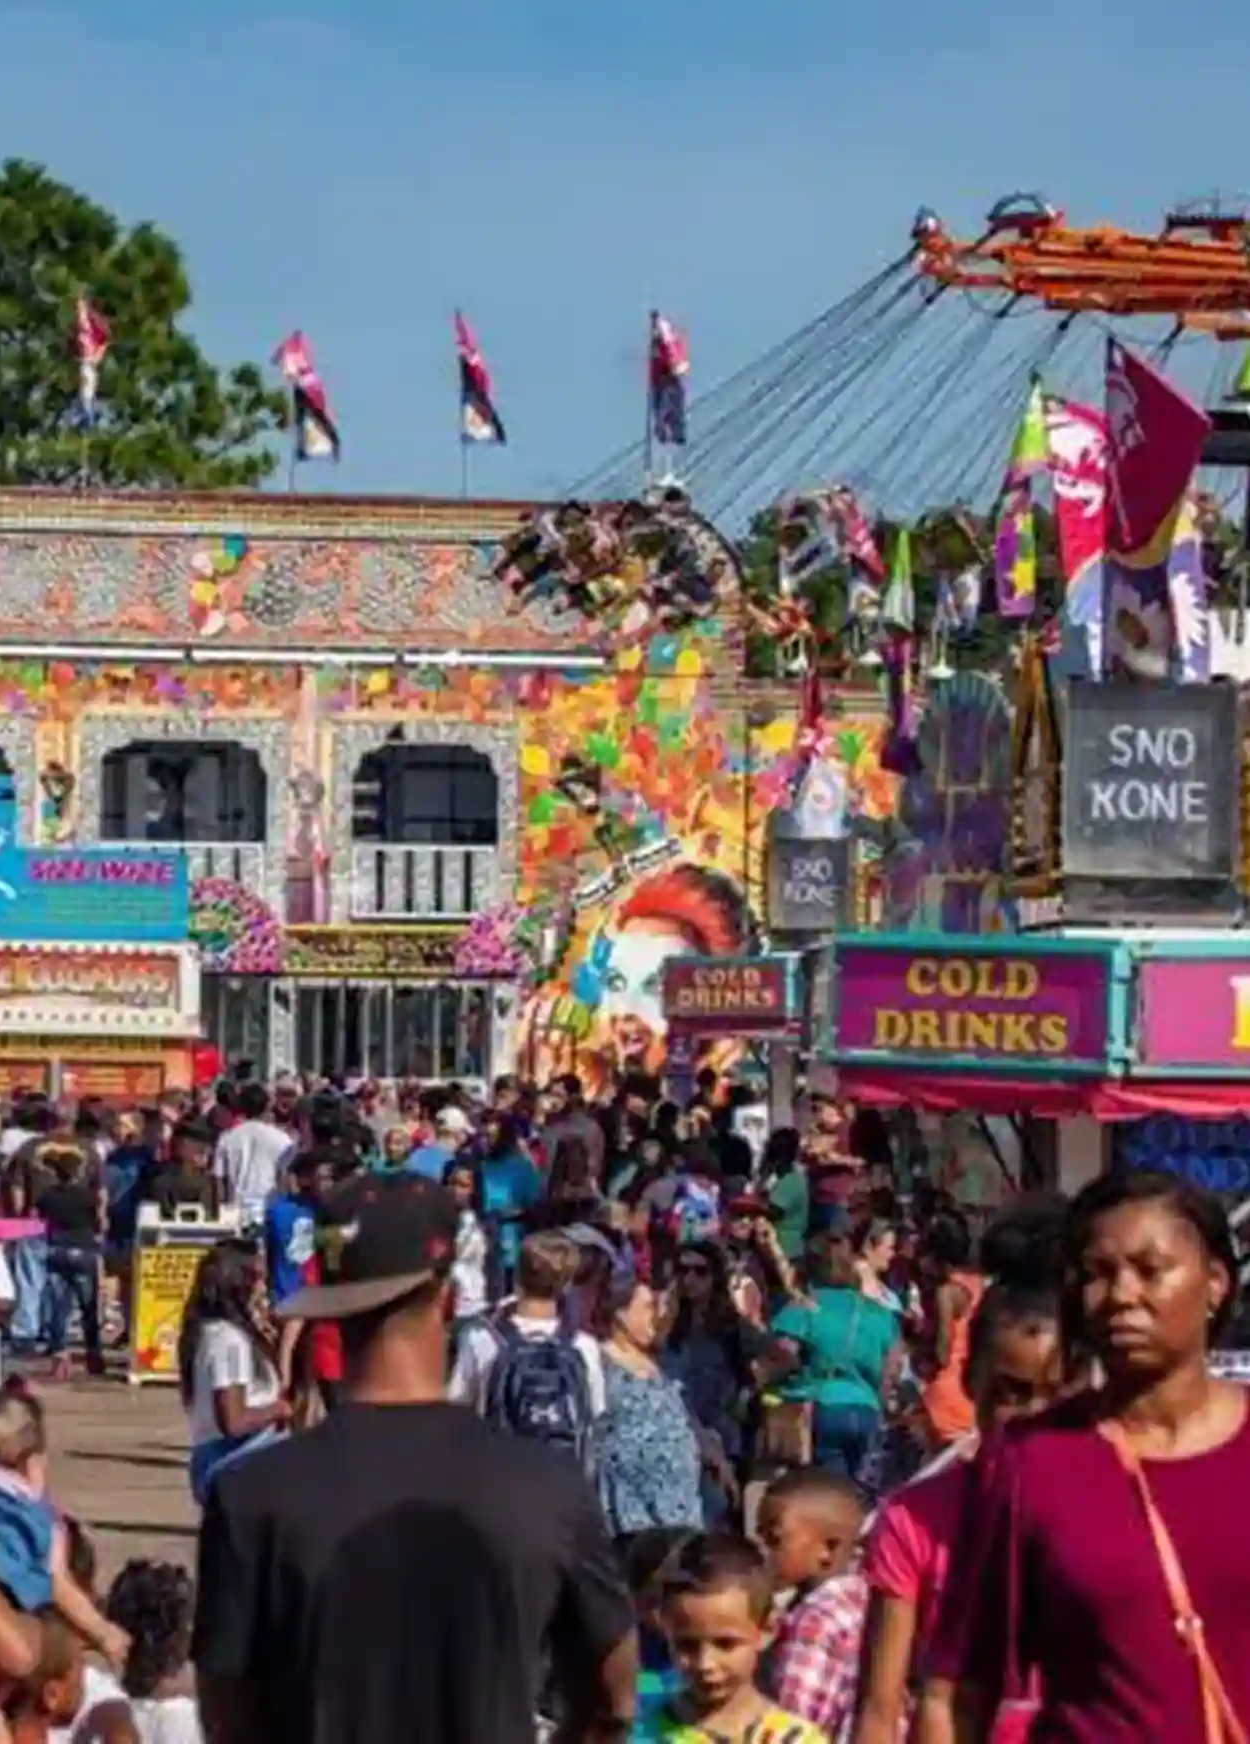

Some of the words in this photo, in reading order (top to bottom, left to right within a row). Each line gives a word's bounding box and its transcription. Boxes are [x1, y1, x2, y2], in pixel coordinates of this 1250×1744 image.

[1108, 724, 1197, 769] SNO
[1086, 779, 1209, 821] KONE
[692, 966, 762, 987] COLD
[906, 958, 1040, 1000] COLD
[675, 986, 777, 1010] DRINKS
[872, 1008, 1069, 1053] DRINKS
